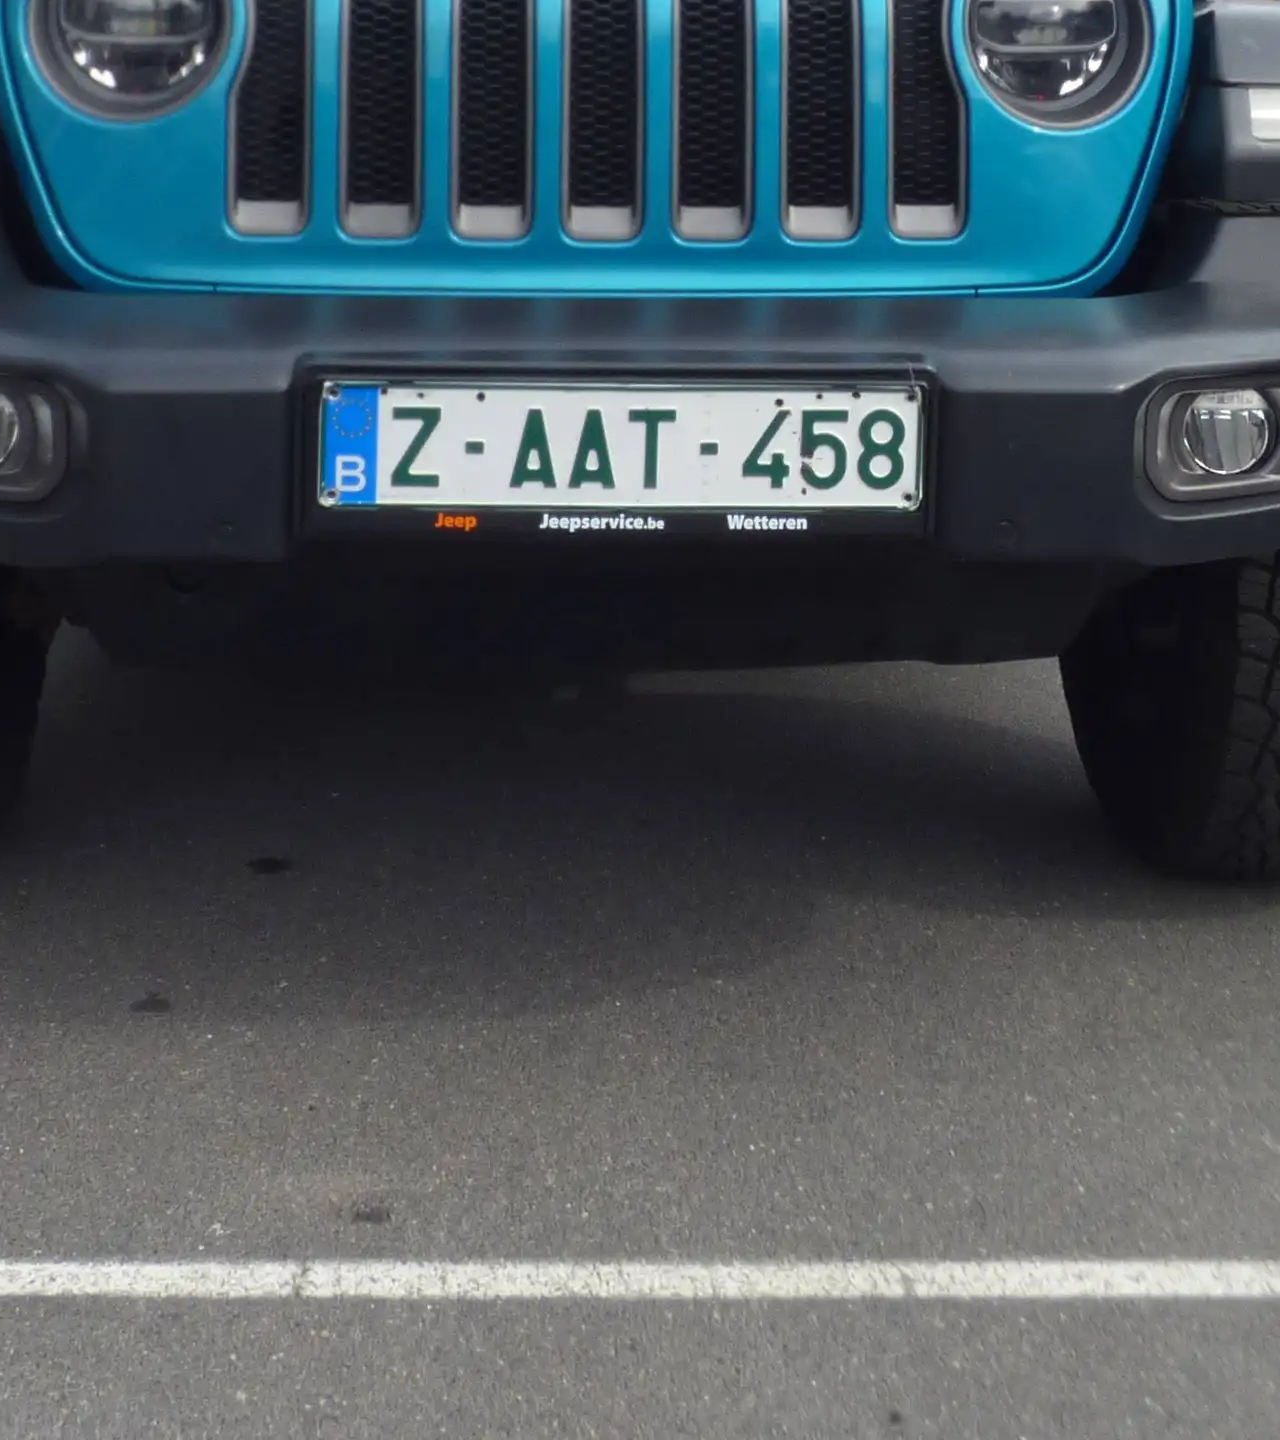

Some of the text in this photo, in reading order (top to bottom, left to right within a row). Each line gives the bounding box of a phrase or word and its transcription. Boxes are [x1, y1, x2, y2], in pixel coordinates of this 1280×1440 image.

[390, 406, 907, 491] Z-AAT-458
[335, 455, 366, 492] B
[434, 512, 808, 533] Jeep Jeepservice.be Wetteren
